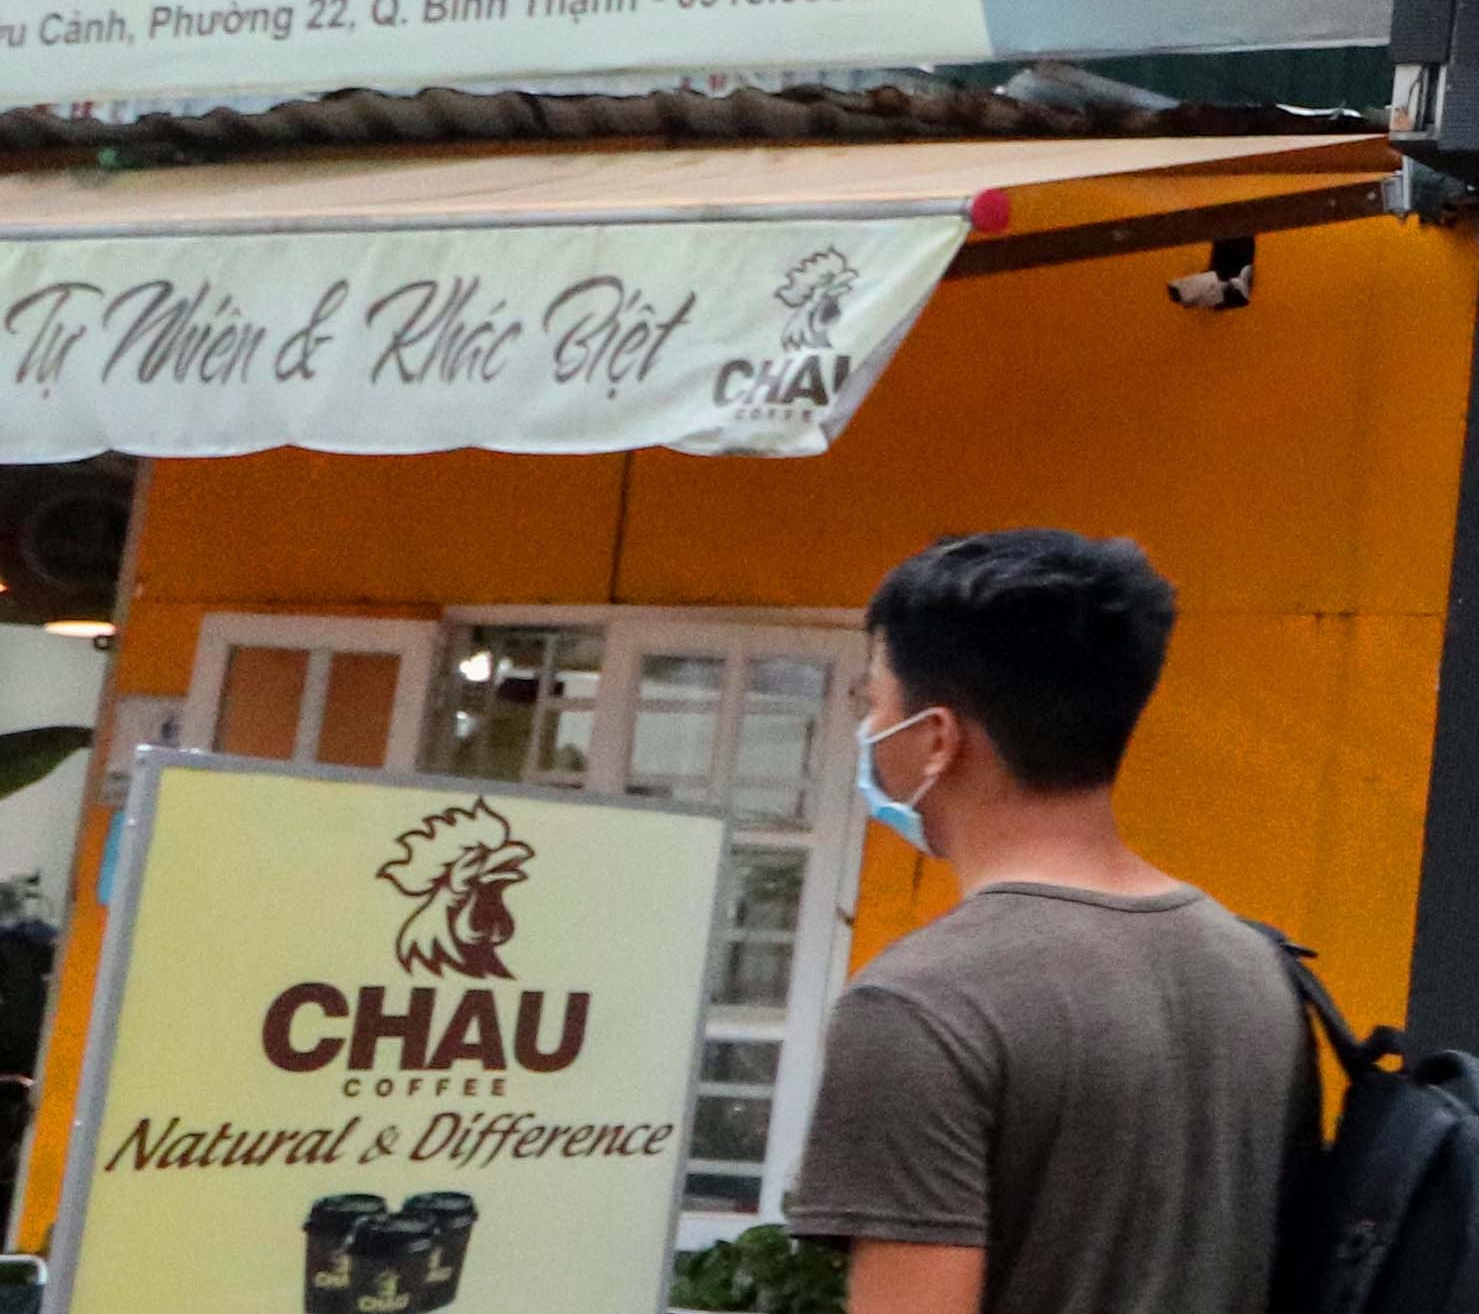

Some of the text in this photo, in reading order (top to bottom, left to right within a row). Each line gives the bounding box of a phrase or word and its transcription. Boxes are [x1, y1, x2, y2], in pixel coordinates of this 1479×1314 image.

[148, 0, 294, 42] Phường
[4, 275, 696, 399] Tự Nhiên & Khác Biệt
[261, 981, 591, 1074] CHAU
[344, 1078, 507, 1098] COFFEE
[105, 1110, 676, 1174] Natural & Difference
